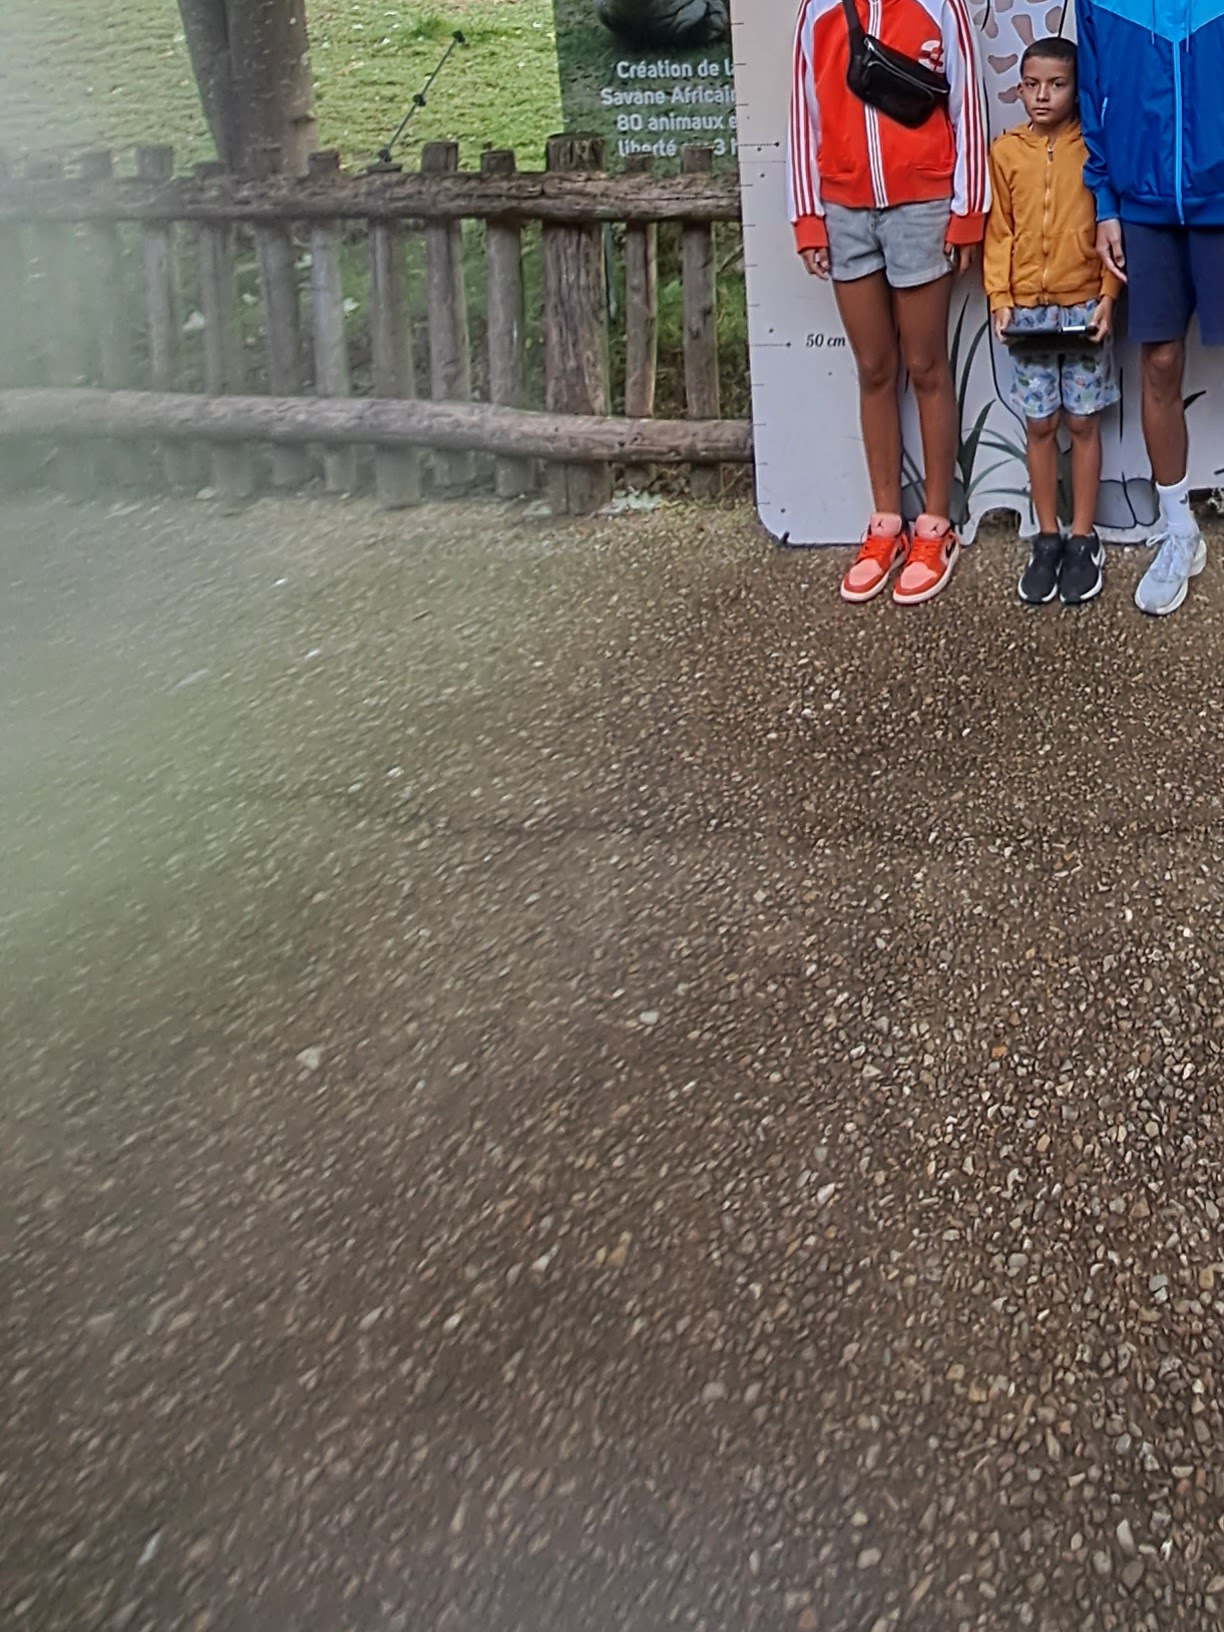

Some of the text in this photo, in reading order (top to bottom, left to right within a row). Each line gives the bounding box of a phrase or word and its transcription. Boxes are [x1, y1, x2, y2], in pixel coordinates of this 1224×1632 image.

[616, 59, 693, 78] Création
[697, 58, 719, 77] de
[601, 87, 665, 105] Savane
[617, 114, 643, 131] 80
[649, 113, 723, 131] animaux
[618, 138, 677, 157] liberté
[713, 139, 725, 156] 3
[805, 333, 846, 348] 50 cm
